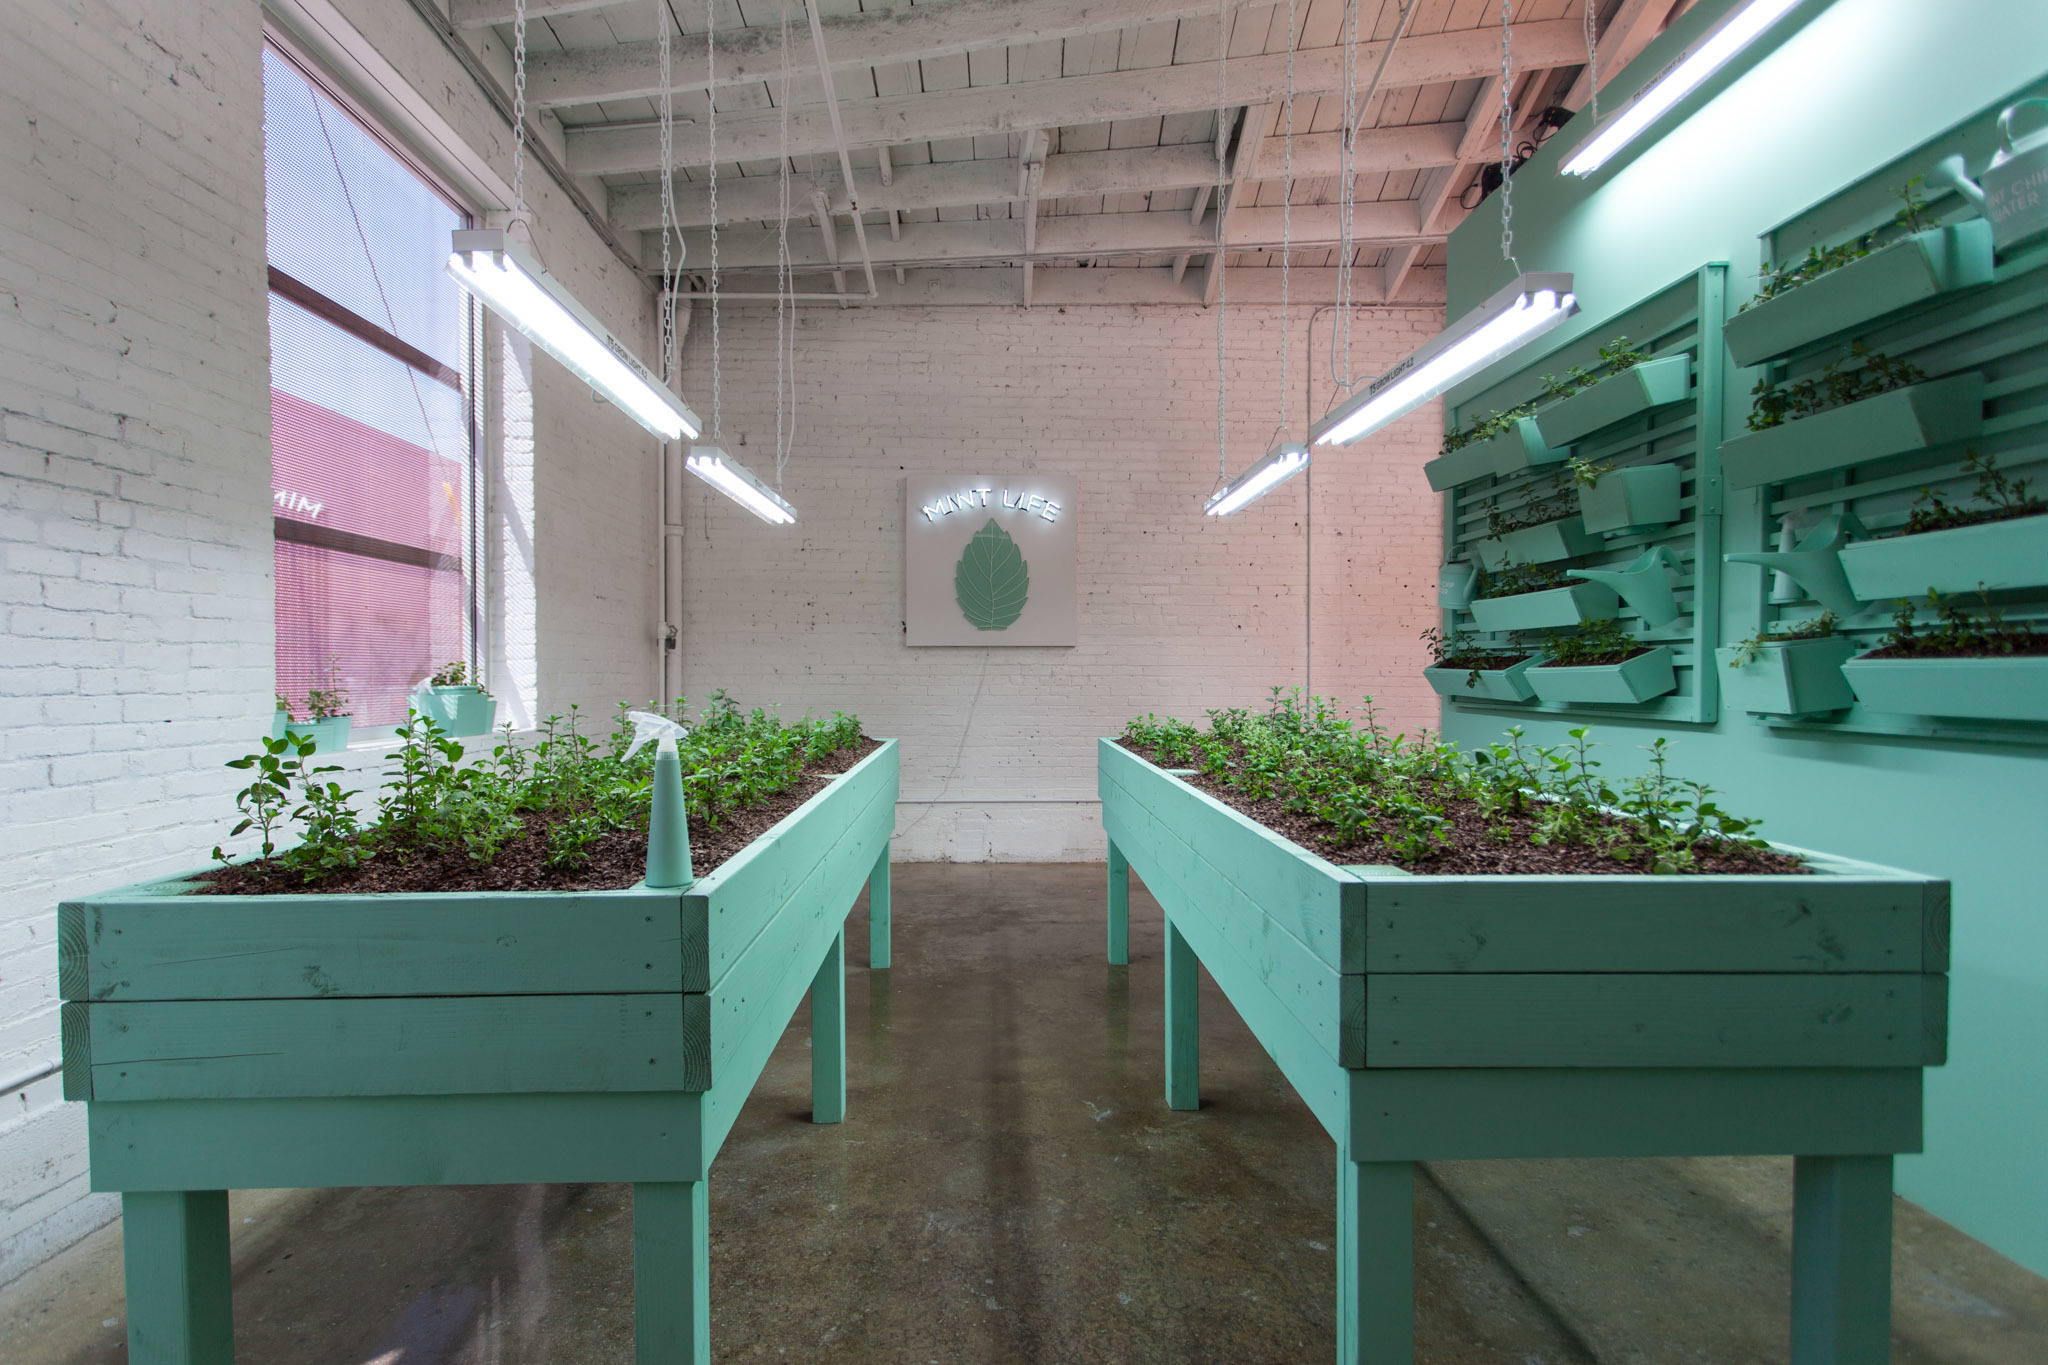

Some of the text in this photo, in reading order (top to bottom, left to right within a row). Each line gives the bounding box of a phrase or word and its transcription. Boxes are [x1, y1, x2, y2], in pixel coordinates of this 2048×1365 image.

[629, 355, 641, 374] LIGHT
[1369, 383, 1377, 395] T5
[1376, 374, 1391, 391] GROW
[1390, 362, 1406, 380] LIGHT
[921, 488, 1061, 523] MINT LIFE
